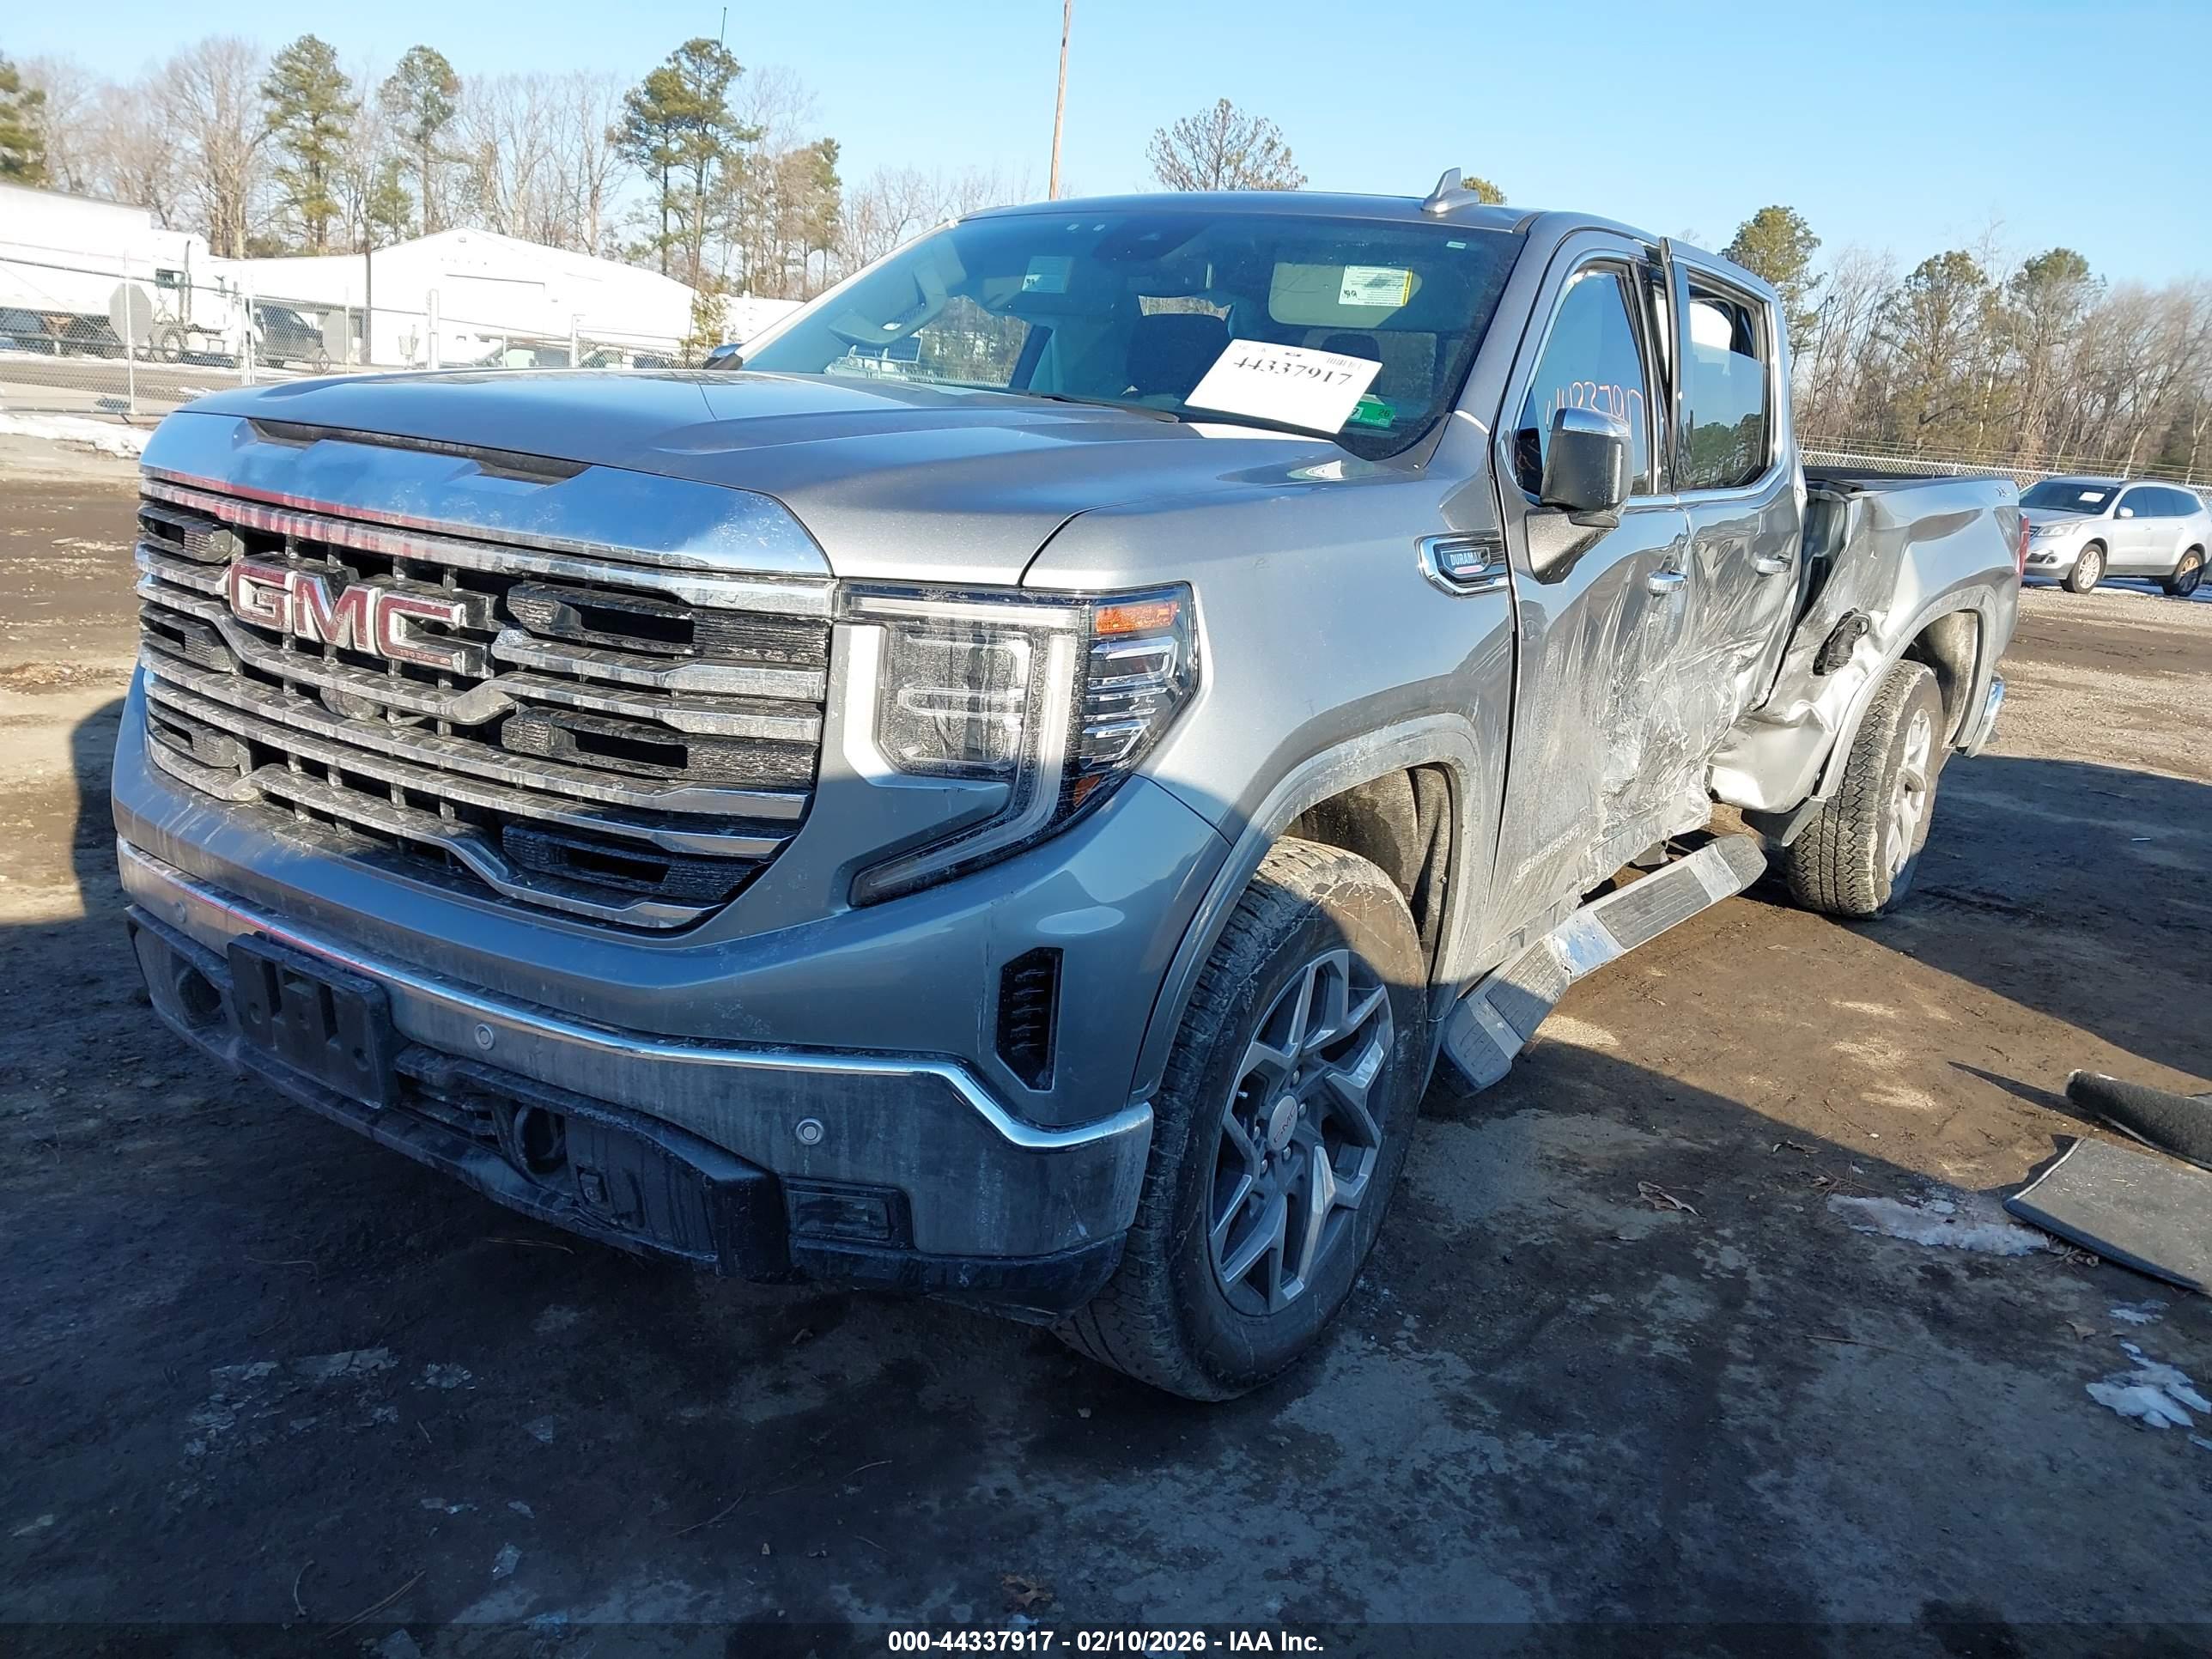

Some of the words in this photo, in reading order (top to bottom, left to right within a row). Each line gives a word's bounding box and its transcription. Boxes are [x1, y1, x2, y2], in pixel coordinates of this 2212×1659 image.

[1232, 356, 1353, 386] 44337917
[1449, 551, 1483, 567] DURAMAX
[228, 560, 467, 673] GMC
[1273, 1104, 1297, 1143] GMC
